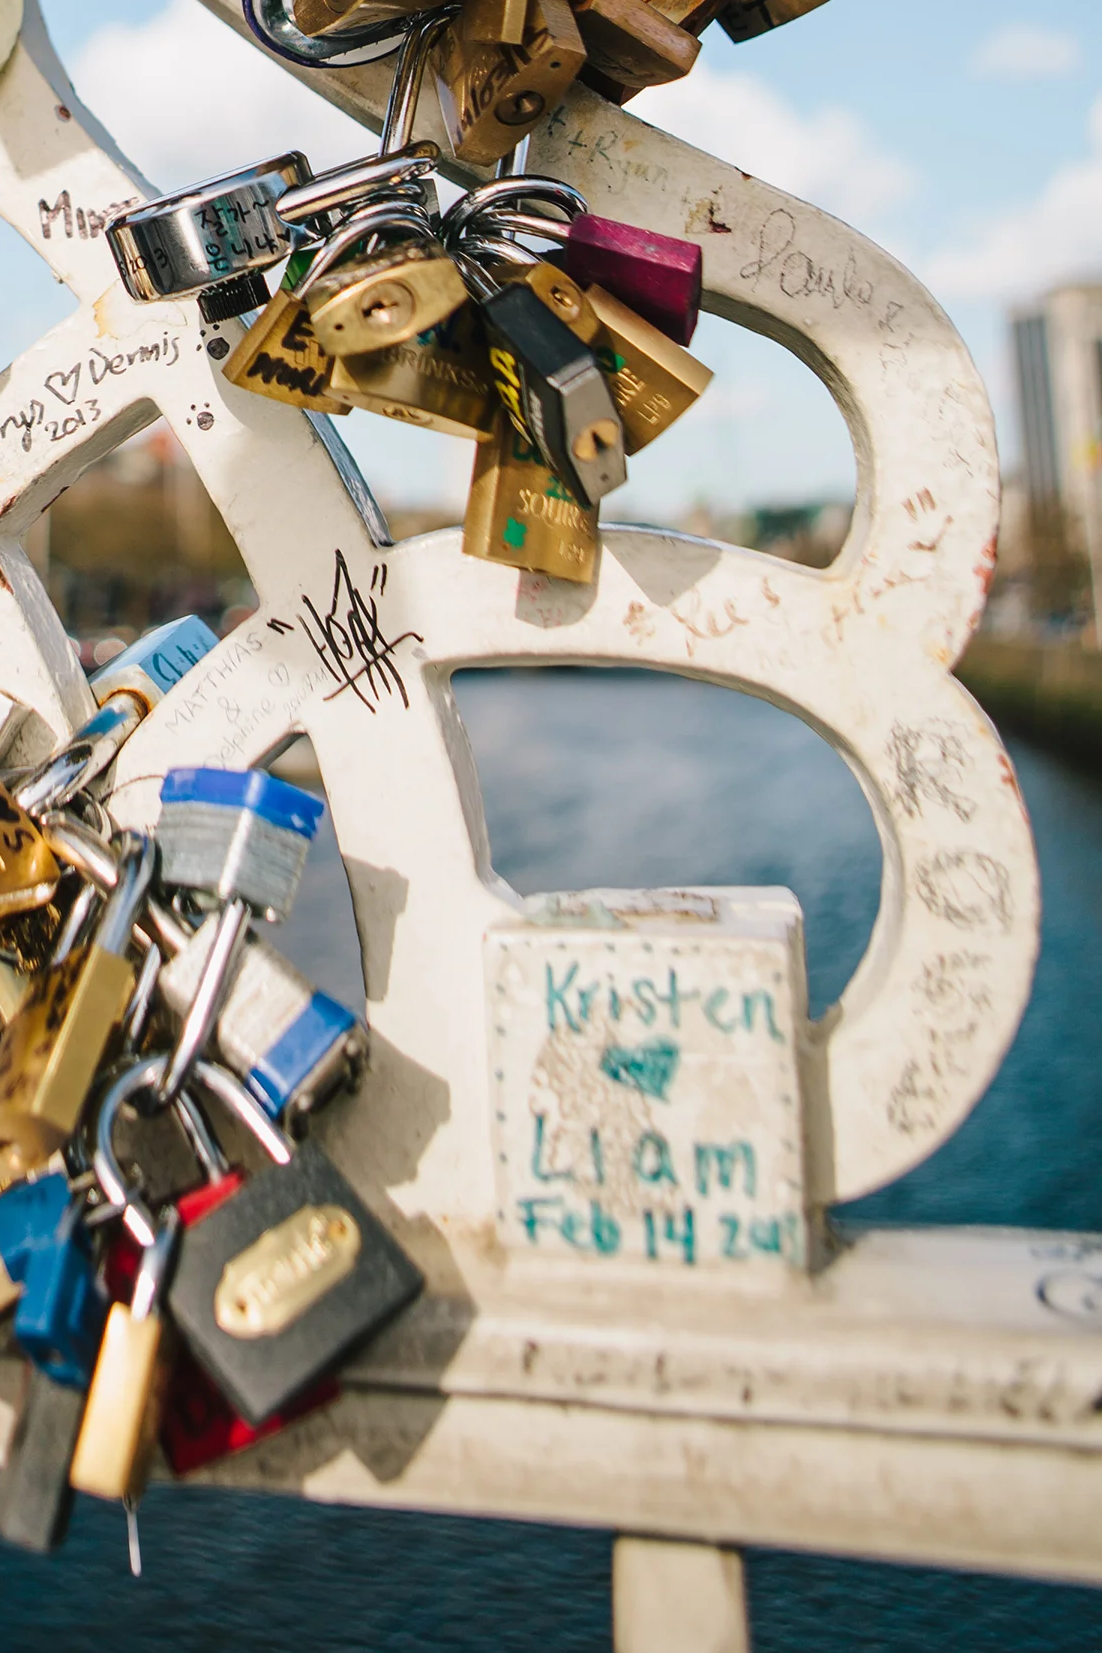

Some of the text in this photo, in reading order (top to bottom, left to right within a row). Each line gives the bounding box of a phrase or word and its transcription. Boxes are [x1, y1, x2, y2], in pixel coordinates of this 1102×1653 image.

[43, 397, 103, 443] 2013
[544, 960, 788, 1046] Kristen
[516, 1195, 622, 1256] Feb
[643, 1203, 697, 1267] 14
